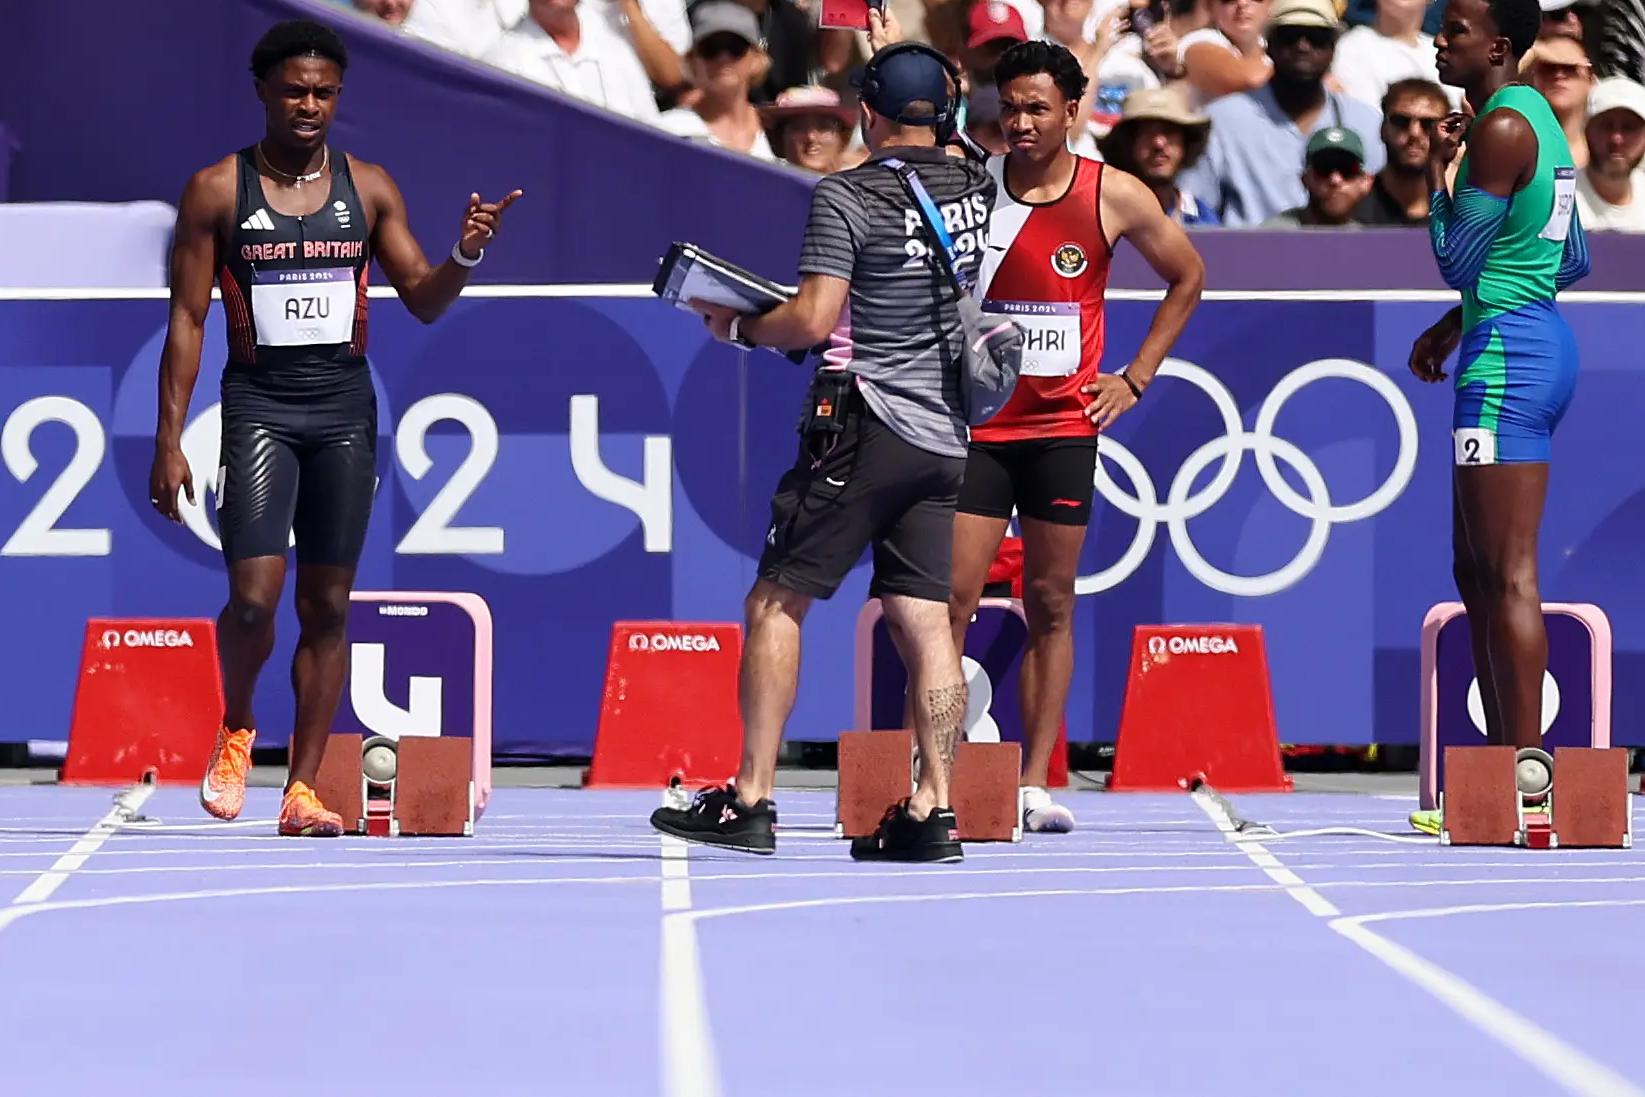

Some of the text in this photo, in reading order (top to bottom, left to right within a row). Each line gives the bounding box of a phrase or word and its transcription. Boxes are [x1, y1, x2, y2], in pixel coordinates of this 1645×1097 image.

[241, 240, 363, 260] GREAT BRITAIN
[279, 272, 334, 281] PARIS 2024
[285, 296, 330, 320] AZU
[1004, 304, 1056, 313] PARIS 2024
[1021, 329, 1065, 351] HRI
[1464, 438, 1481, 462] 2
[124, 630, 194, 647] OMEGA
[651, 634, 721, 651] OMEGA
[1169, 636, 1239, 654] OMEGA
[351, 643, 442, 737] 4
